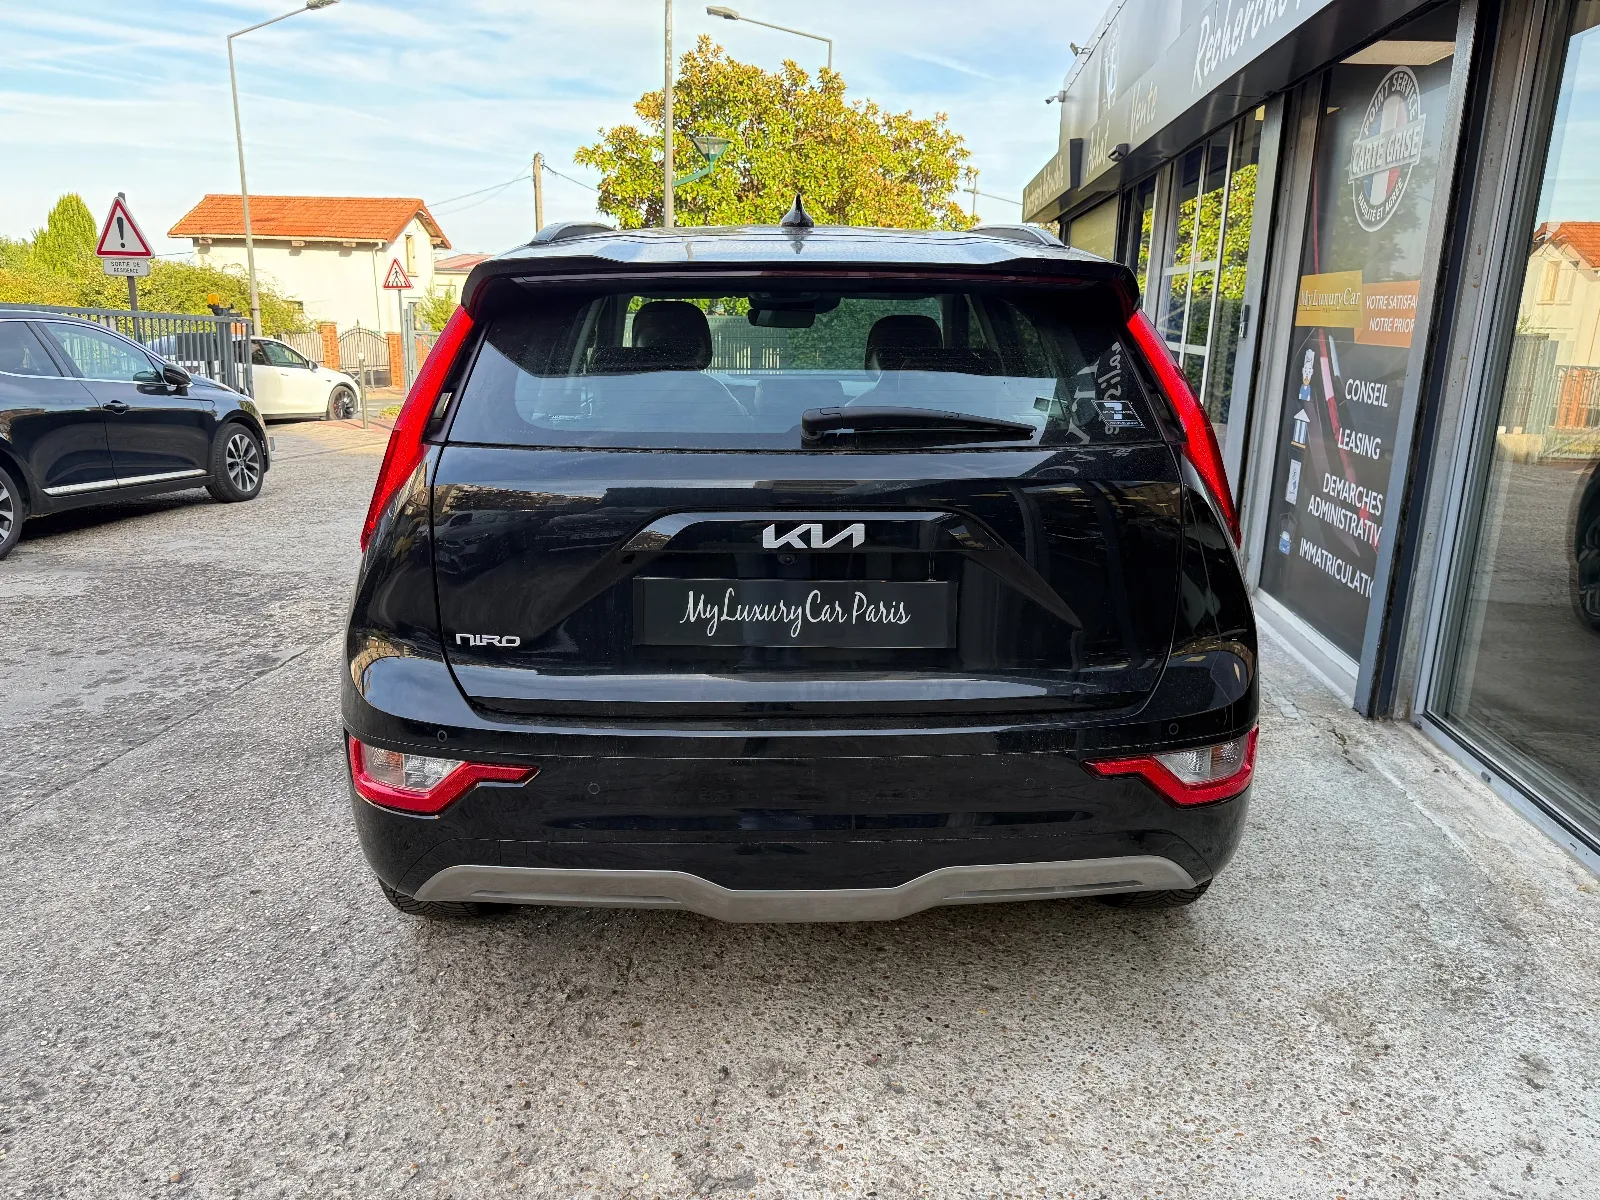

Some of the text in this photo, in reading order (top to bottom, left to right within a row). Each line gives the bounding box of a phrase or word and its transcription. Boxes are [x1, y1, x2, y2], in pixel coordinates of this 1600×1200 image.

[1130, 81, 1158, 140] Vente
[1364, 73, 1418, 136] POINT SERVICE
[1352, 124, 1421, 174] CARTE GRISE
[1299, 287, 1361, 310] MyLuxuryCar
[1366, 294, 1419, 310] VOTRE SATISFA
[1369, 317, 1394, 331] NOTRE
[1345, 378, 1389, 408] CONSEIL
[1337, 427, 1382, 460] LEASING
[1322, 472, 1383, 517] DEMARCHES
[762, 523, 866, 549] KIA
[1307, 494, 1383, 547] ADMINISTRATIV
[679, 587, 911, 638] MyLuxuryCar Paris
[455, 633, 521, 647] NIRO
